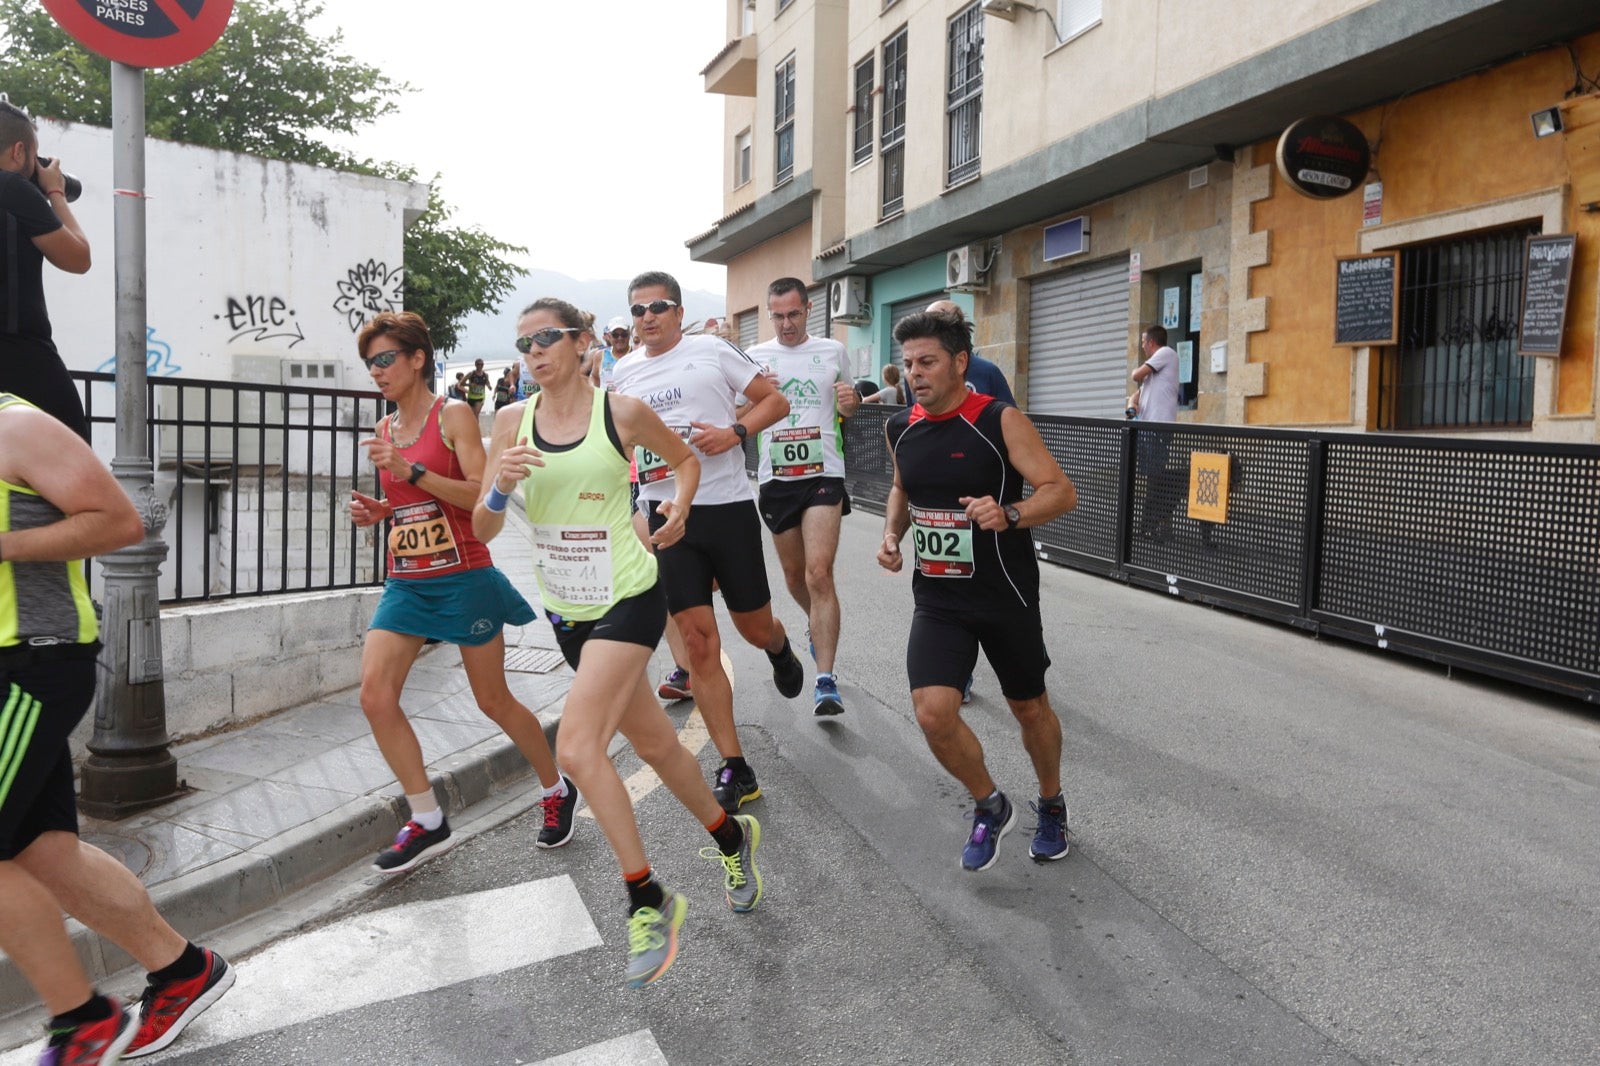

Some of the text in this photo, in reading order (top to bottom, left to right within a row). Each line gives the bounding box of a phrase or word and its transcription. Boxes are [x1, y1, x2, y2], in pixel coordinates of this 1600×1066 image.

[96, 5, 145, 26] PARES
[641, 387, 682, 405] XCON
[783, 443, 809, 462] 60
[578, 492, 605, 501] AURORA
[396, 523, 449, 550] 2012
[915, 529, 961, 557] 902
